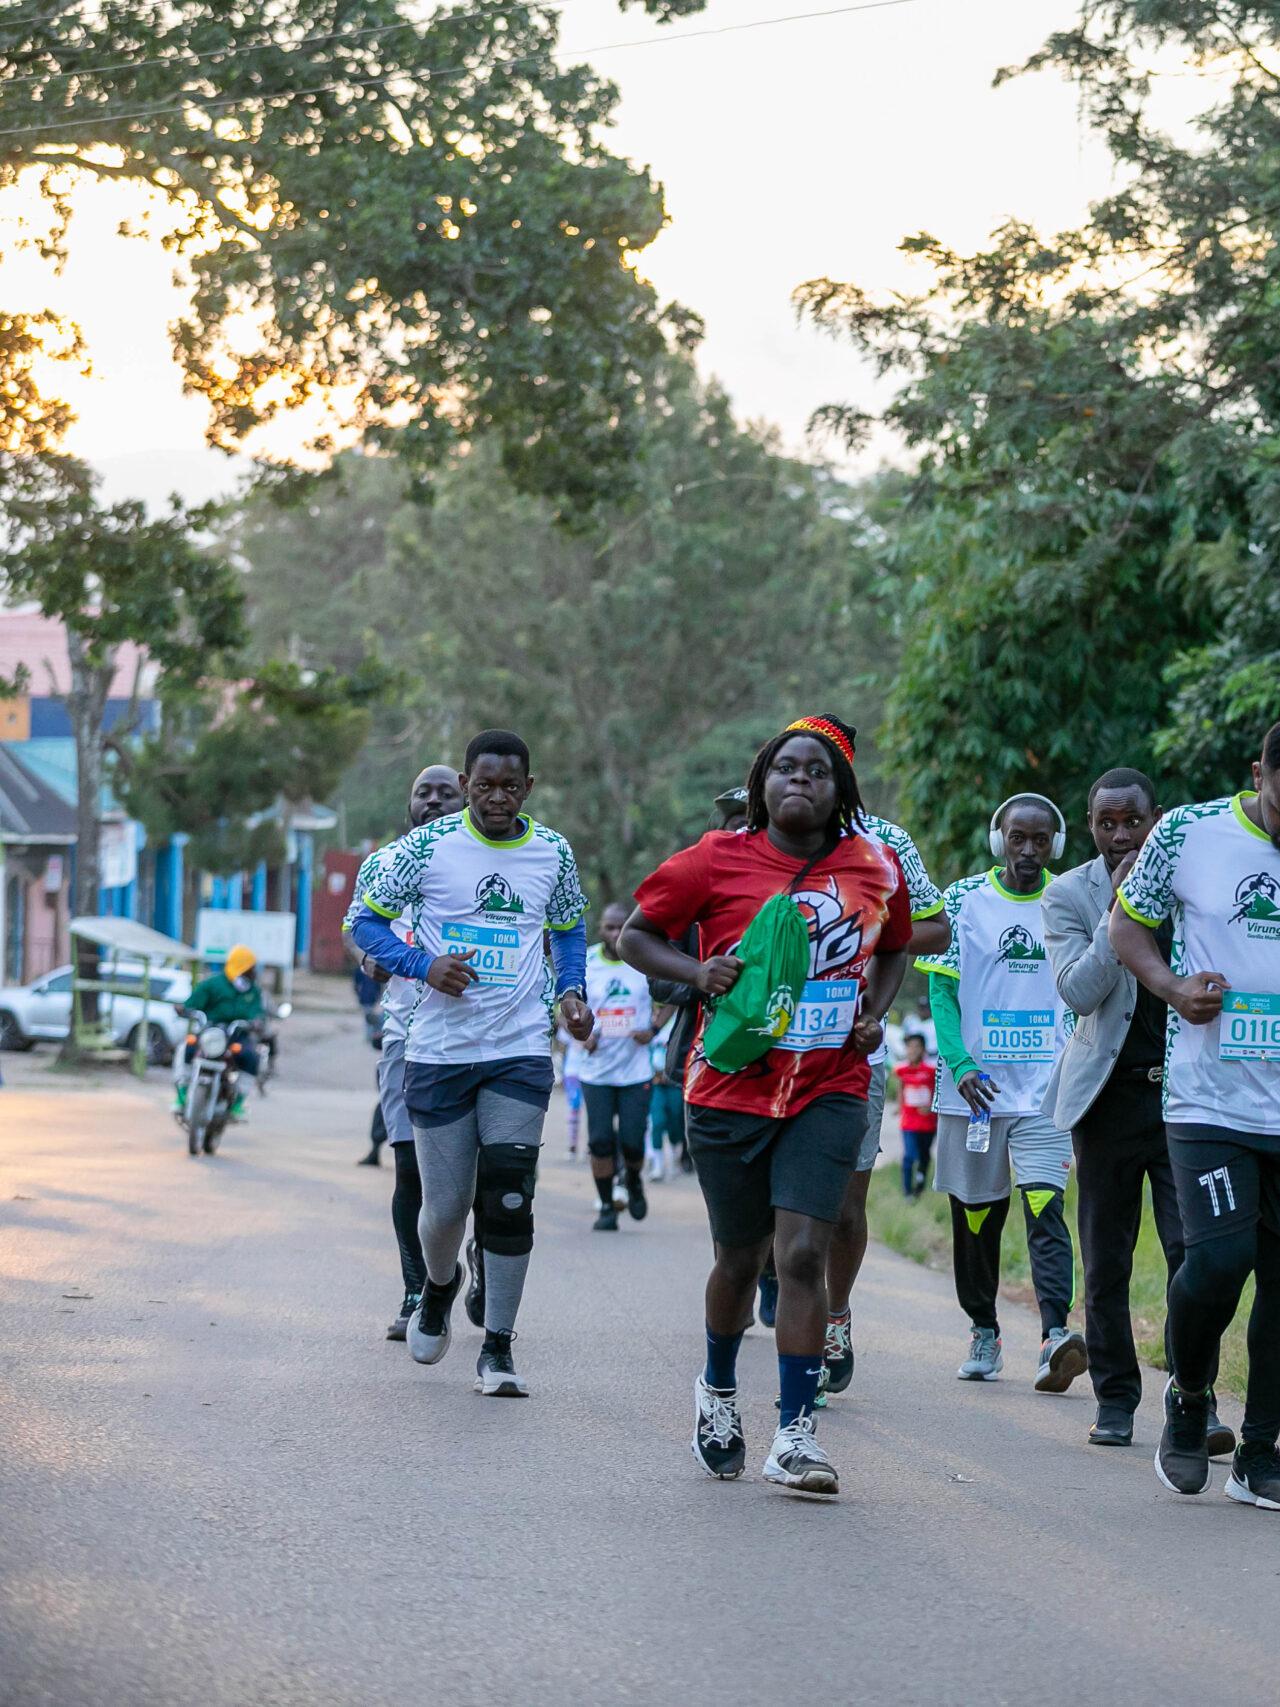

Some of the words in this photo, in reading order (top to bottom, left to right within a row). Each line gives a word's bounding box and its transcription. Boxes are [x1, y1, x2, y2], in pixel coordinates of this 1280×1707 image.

[485, 912, 517, 923] Virunga
[493, 933, 516, 945] 10KM
[447, 944, 505, 970] 01061
[820, 956, 868, 981] ERGY
[1008, 961, 1039, 970] Virunga
[826, 987, 851, 999] 10KM
[1029, 1014, 1050, 1024] 10KM
[988, 1029, 1043, 1048] 01055
[1198, 1166, 1236, 1217] 77
